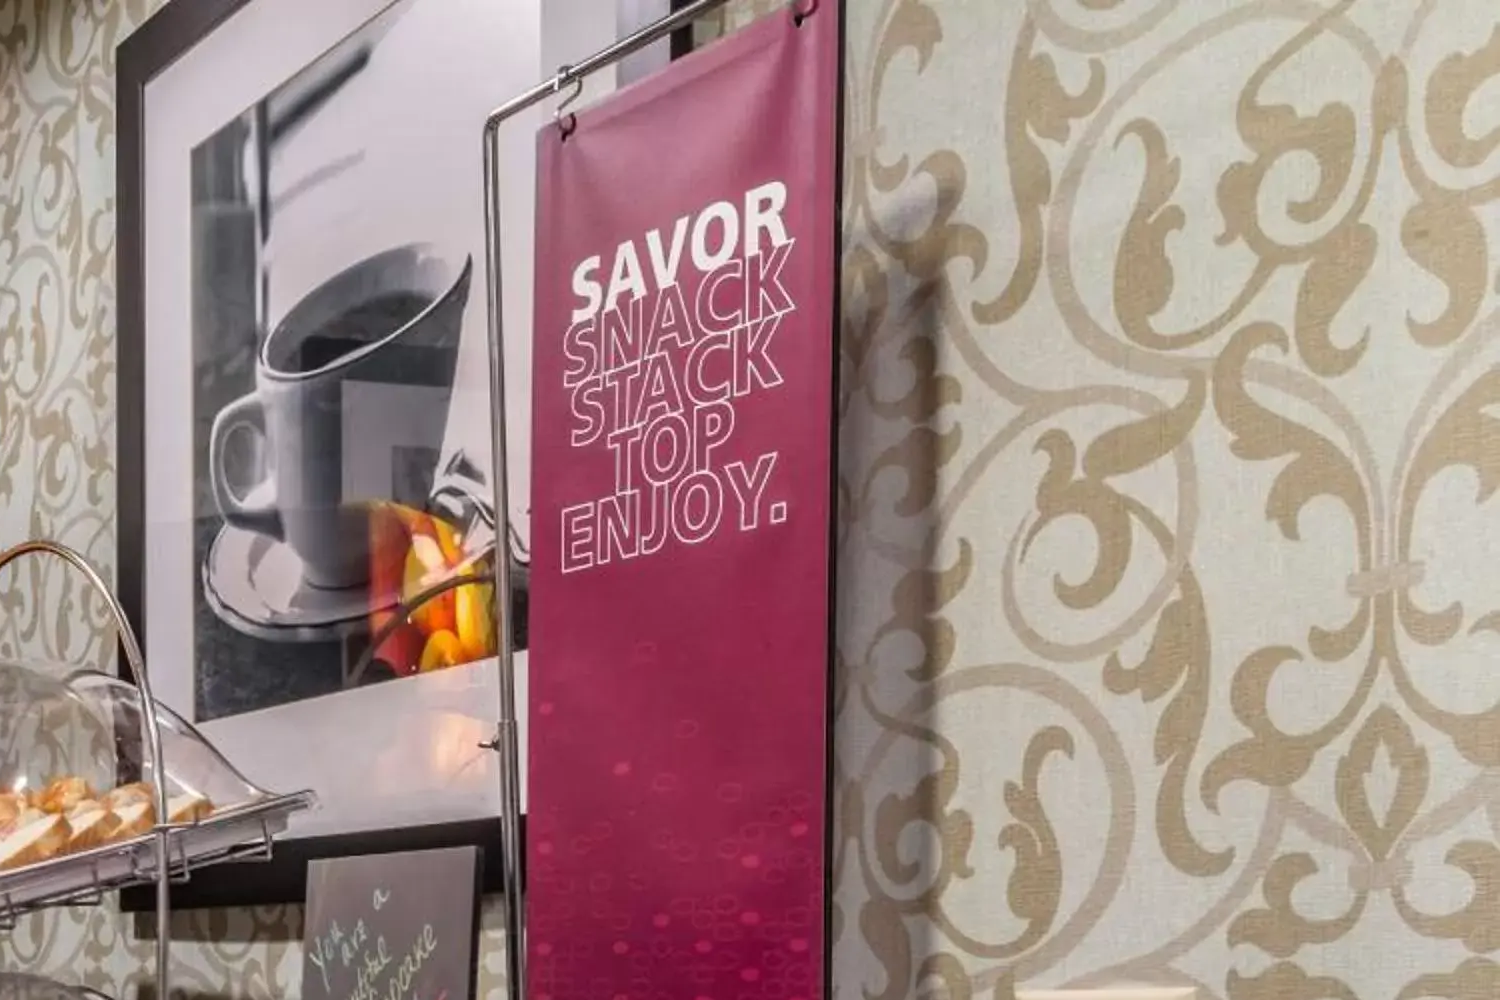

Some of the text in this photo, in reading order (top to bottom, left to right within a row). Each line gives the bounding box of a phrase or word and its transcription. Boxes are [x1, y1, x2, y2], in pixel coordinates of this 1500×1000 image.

[563, 238, 795, 387] SNACK
[571, 181, 787, 322] SAVOR
[571, 313, 784, 447] STACK
[561, 452, 787, 573] ENJOY.
[607, 402, 735, 495] TOP
